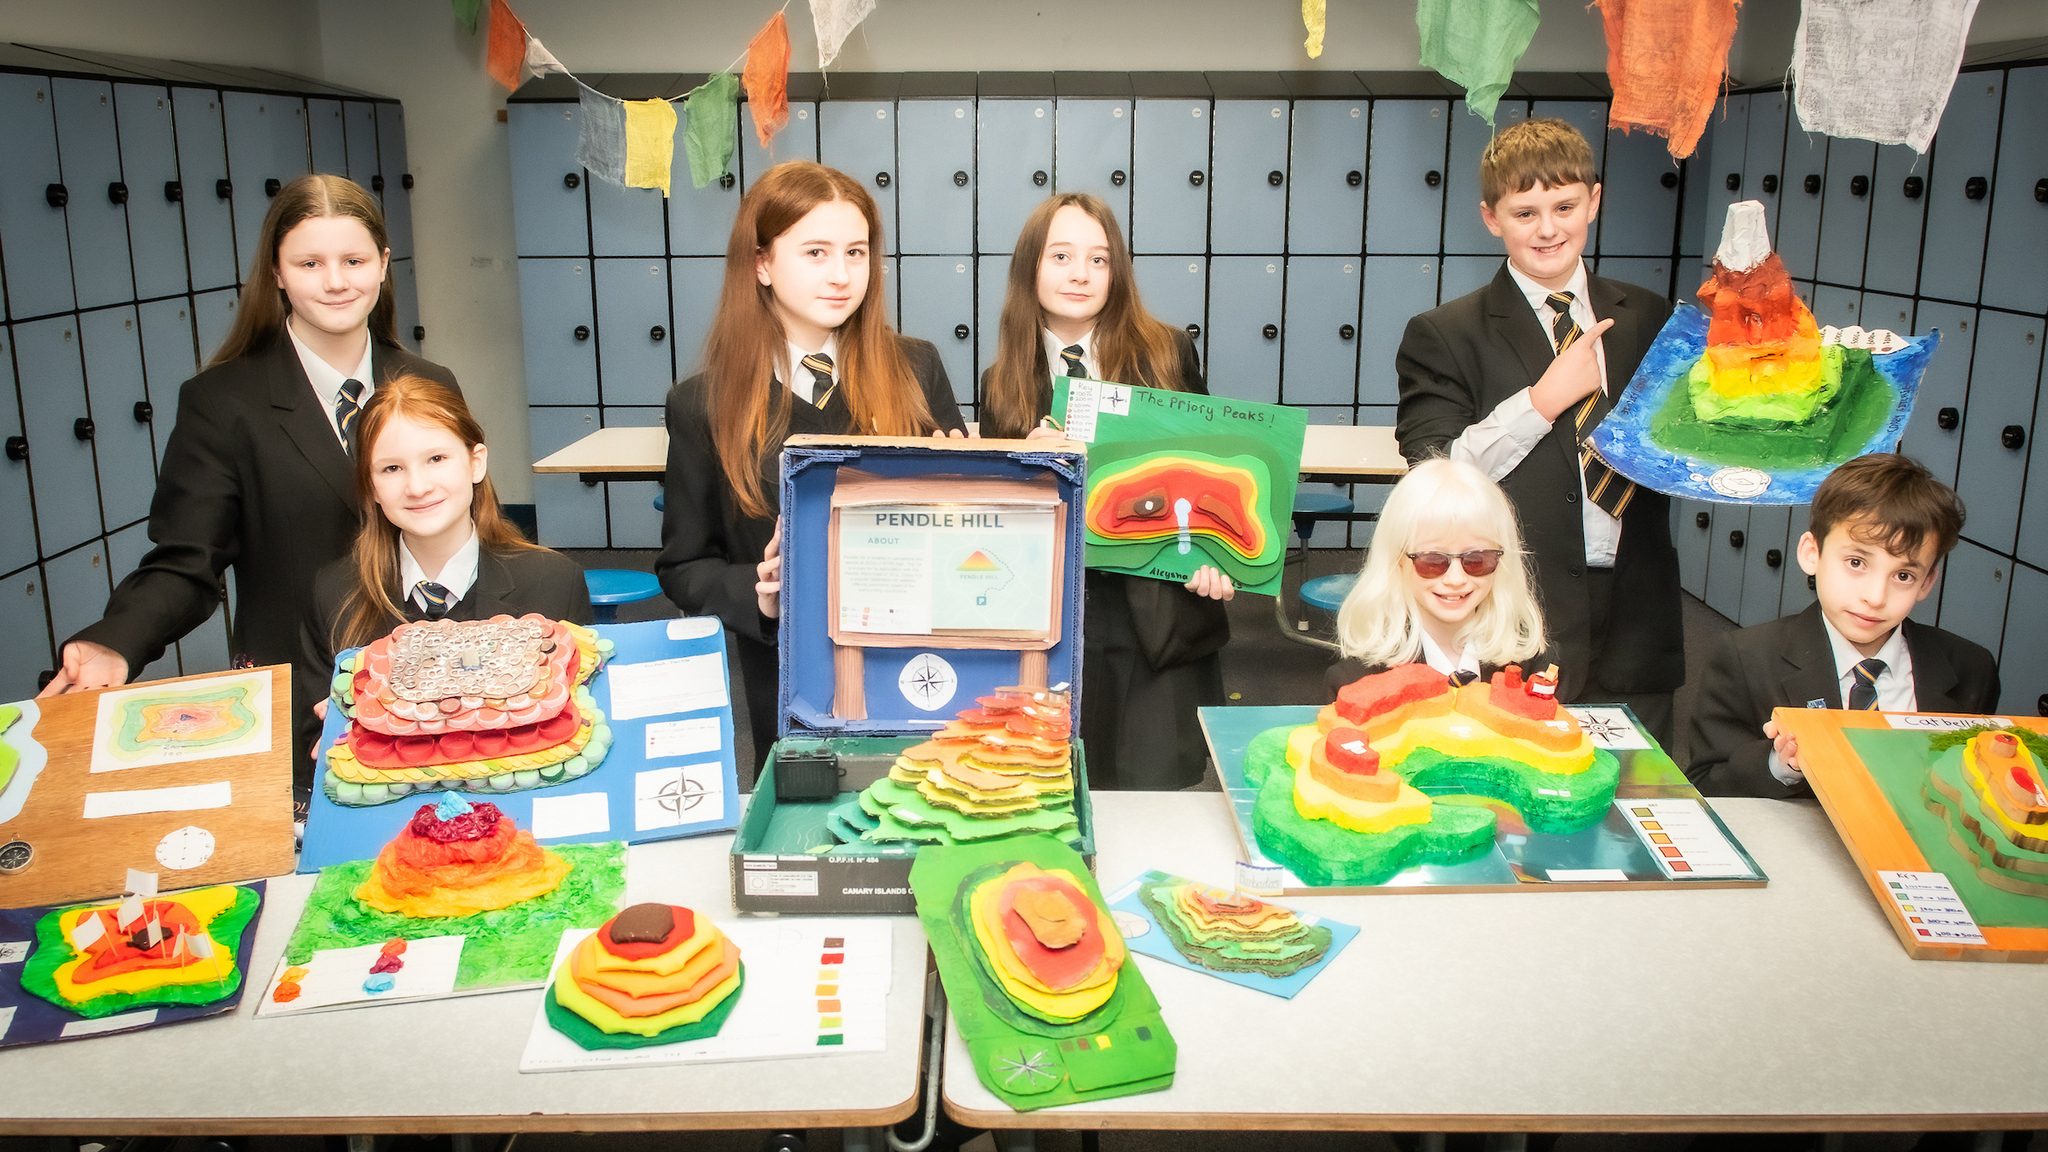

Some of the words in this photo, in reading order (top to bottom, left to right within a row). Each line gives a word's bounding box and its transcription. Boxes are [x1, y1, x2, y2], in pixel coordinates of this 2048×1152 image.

[1078, 381, 1093, 393] Key
[1136, 390, 1164, 407] The
[1170, 396, 1214, 422] Priory
[876, 513, 954, 528] PENDLE
[961, 514, 1004, 528] HILL
[867, 537, 900, 545] ABOUT
